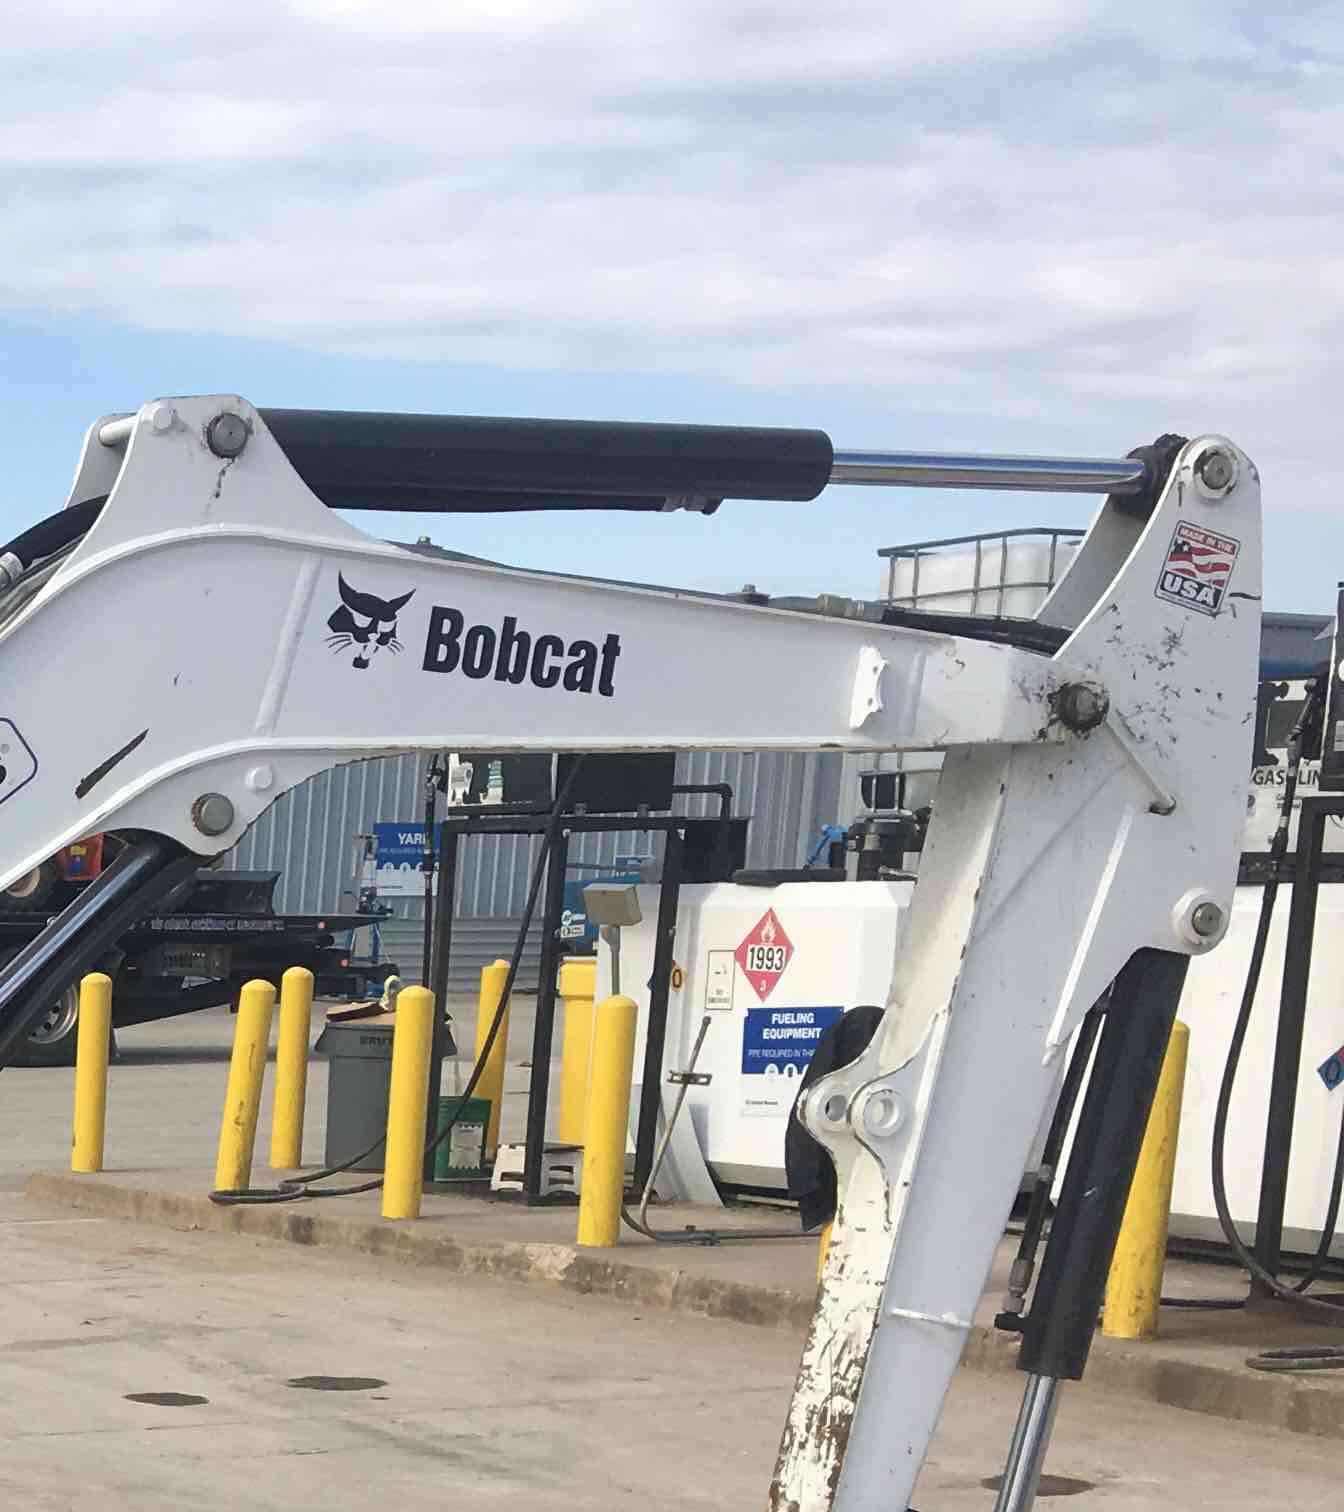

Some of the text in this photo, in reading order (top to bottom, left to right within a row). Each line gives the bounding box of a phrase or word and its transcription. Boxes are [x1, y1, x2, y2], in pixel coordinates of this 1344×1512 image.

[1163, 573, 1216, 607] USA
[422, 606, 621, 697] Bobcat
[398, 833, 426, 845] YAR
[749, 946, 784, 971] 1993
[772, 1012, 815, 1025] FUELING
[762, 1027, 823, 1040] EQUIPMENT
